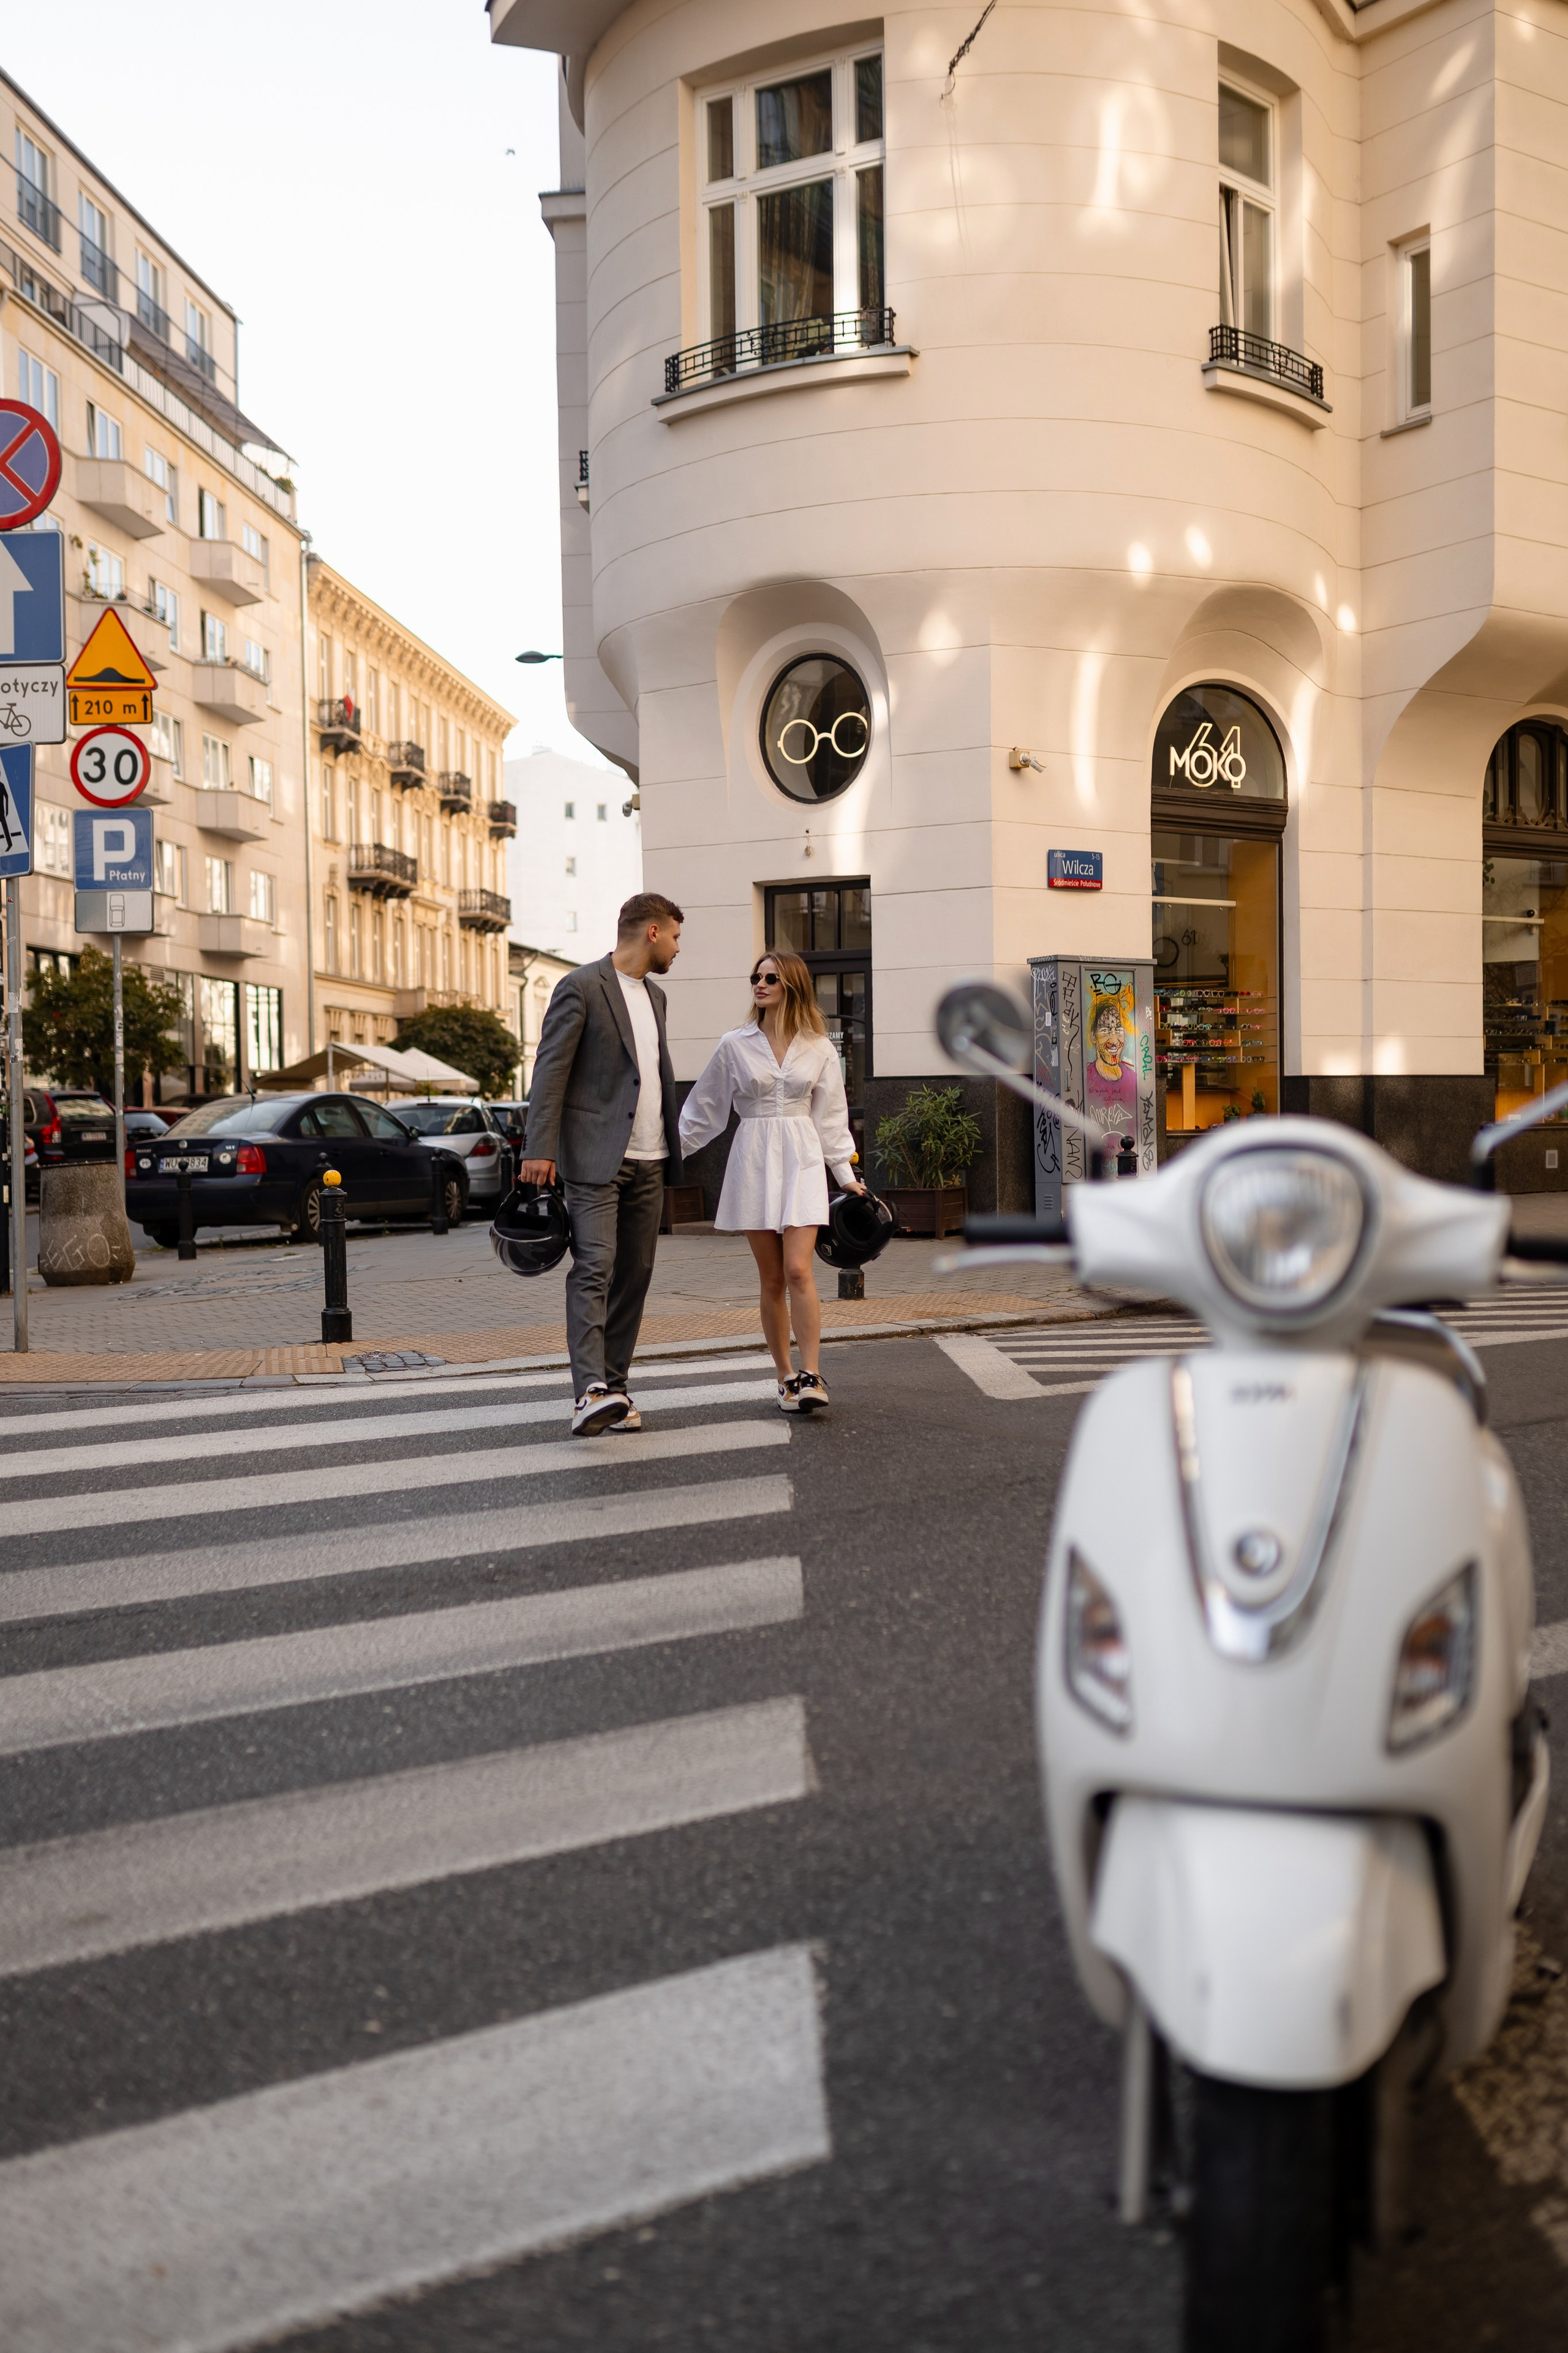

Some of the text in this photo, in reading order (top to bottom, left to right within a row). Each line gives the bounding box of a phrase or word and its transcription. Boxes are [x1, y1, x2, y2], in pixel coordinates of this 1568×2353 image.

[85, 700, 137, 715] 210 m
[83, 747, 138, 785] 30
[92, 818, 135, 881] P
[1062, 859, 1094, 876] Wilcza
[109, 870, 145, 883] Płatny
[1053, 878, 1101, 888] Śródmieście Południowe
[1182, 929, 1196, 946] 61
